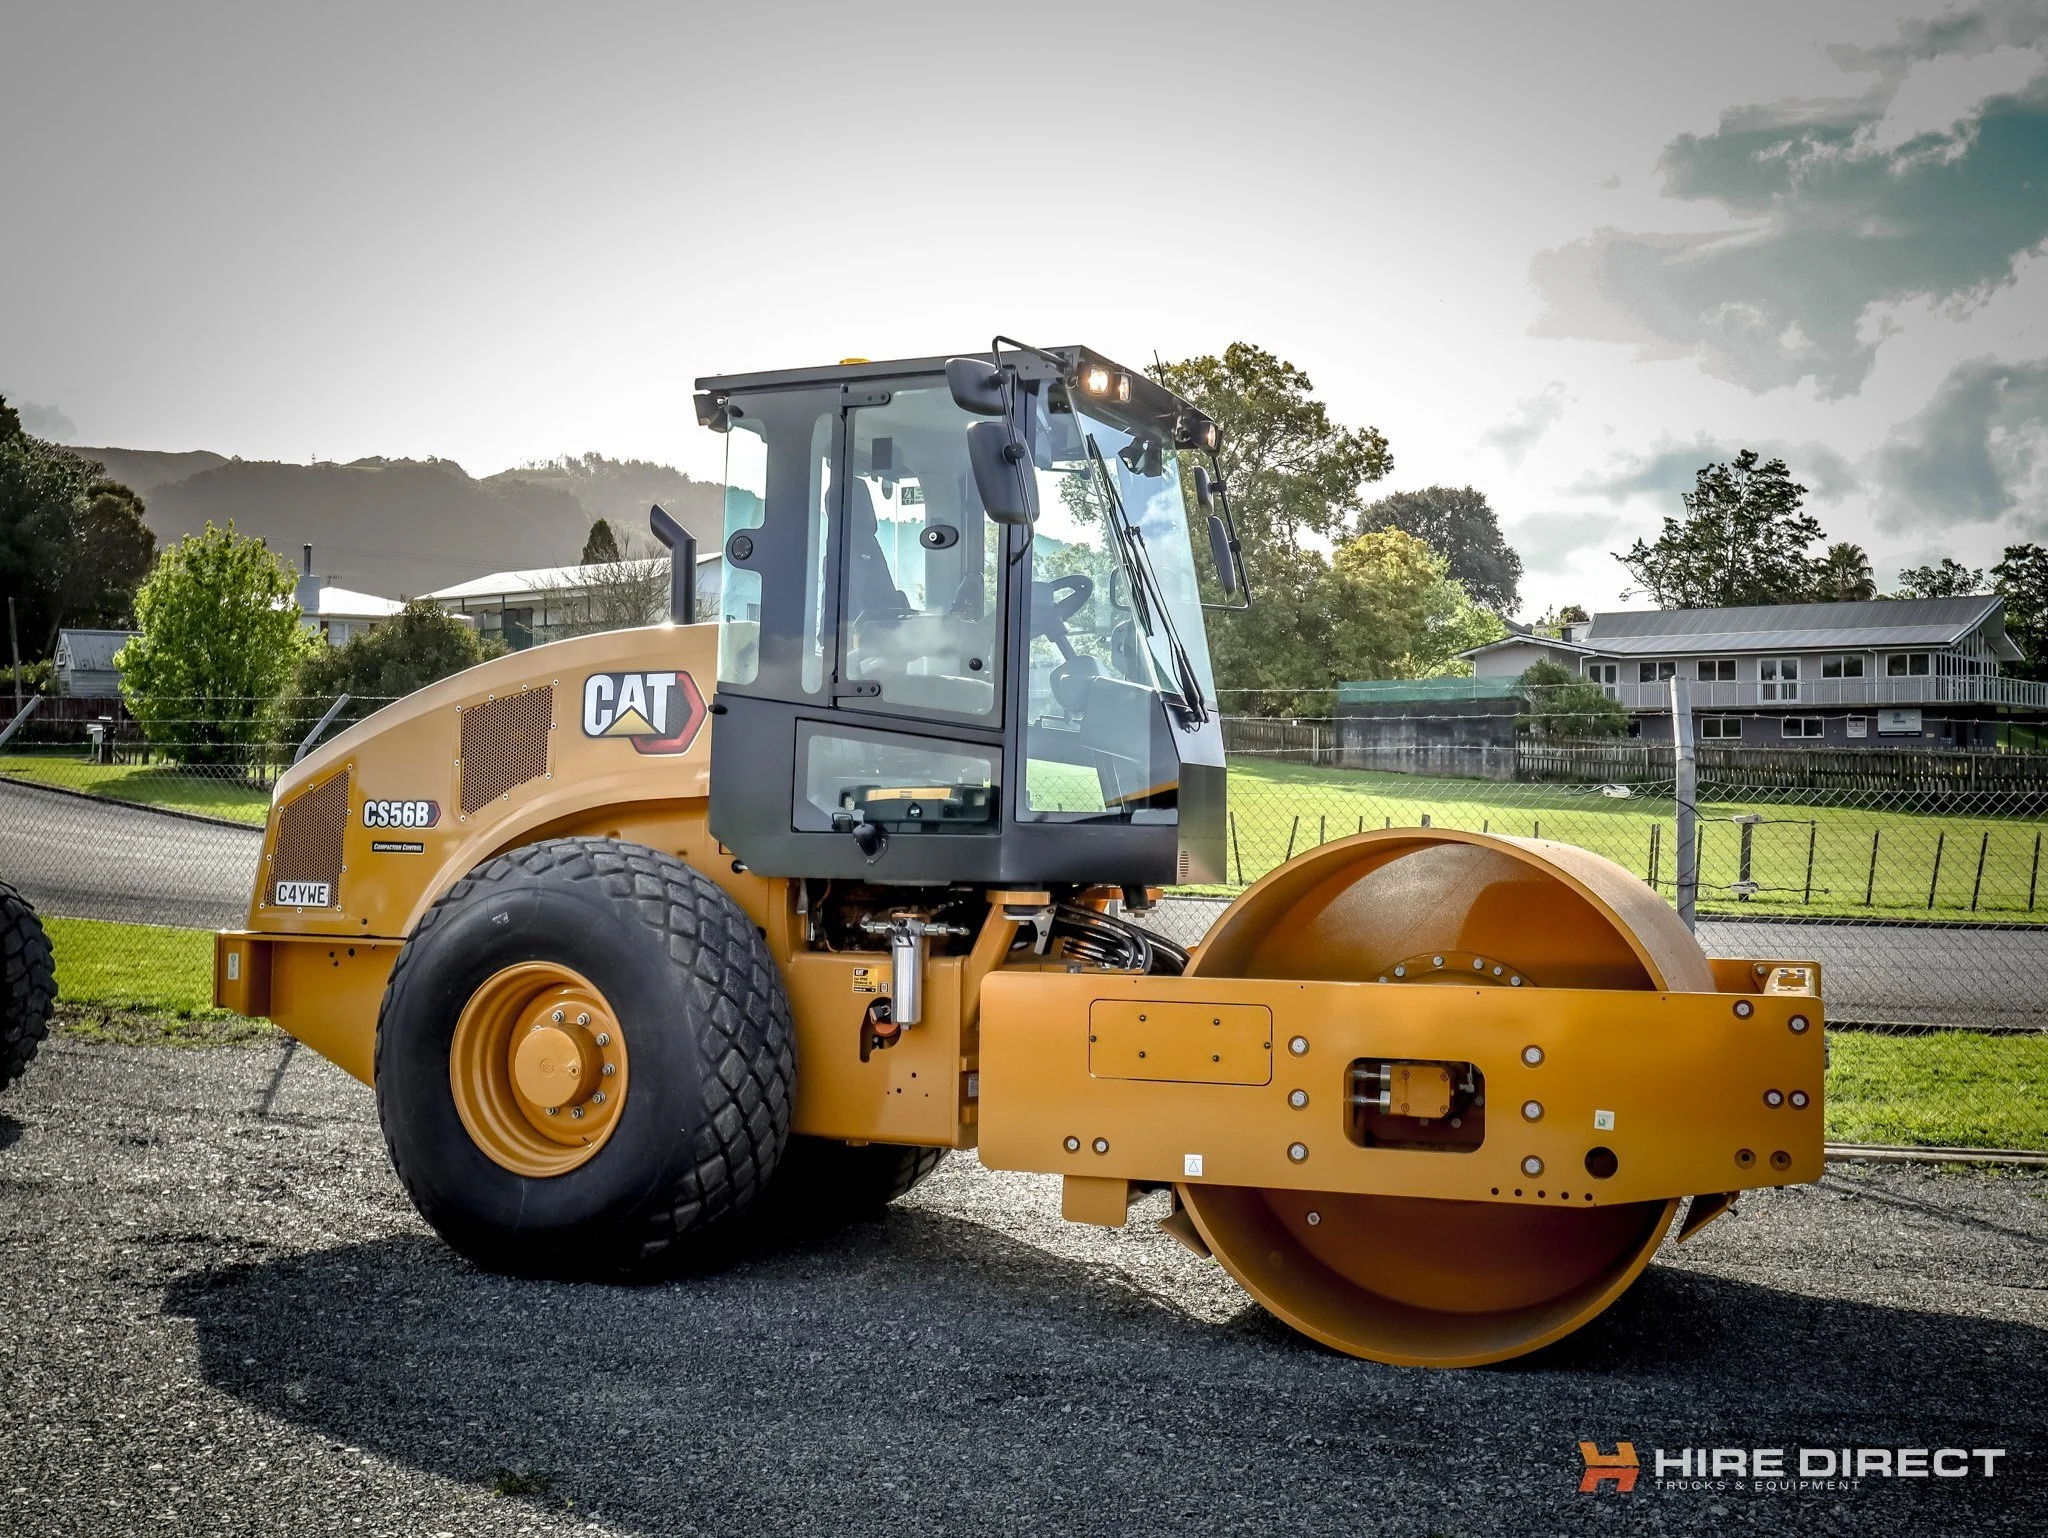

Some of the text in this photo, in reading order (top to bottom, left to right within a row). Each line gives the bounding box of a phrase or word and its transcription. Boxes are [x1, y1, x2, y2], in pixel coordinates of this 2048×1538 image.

[584, 673, 676, 736] CAT
[363, 801, 429, 827] CS56B
[278, 884, 326, 904] C4YWE
